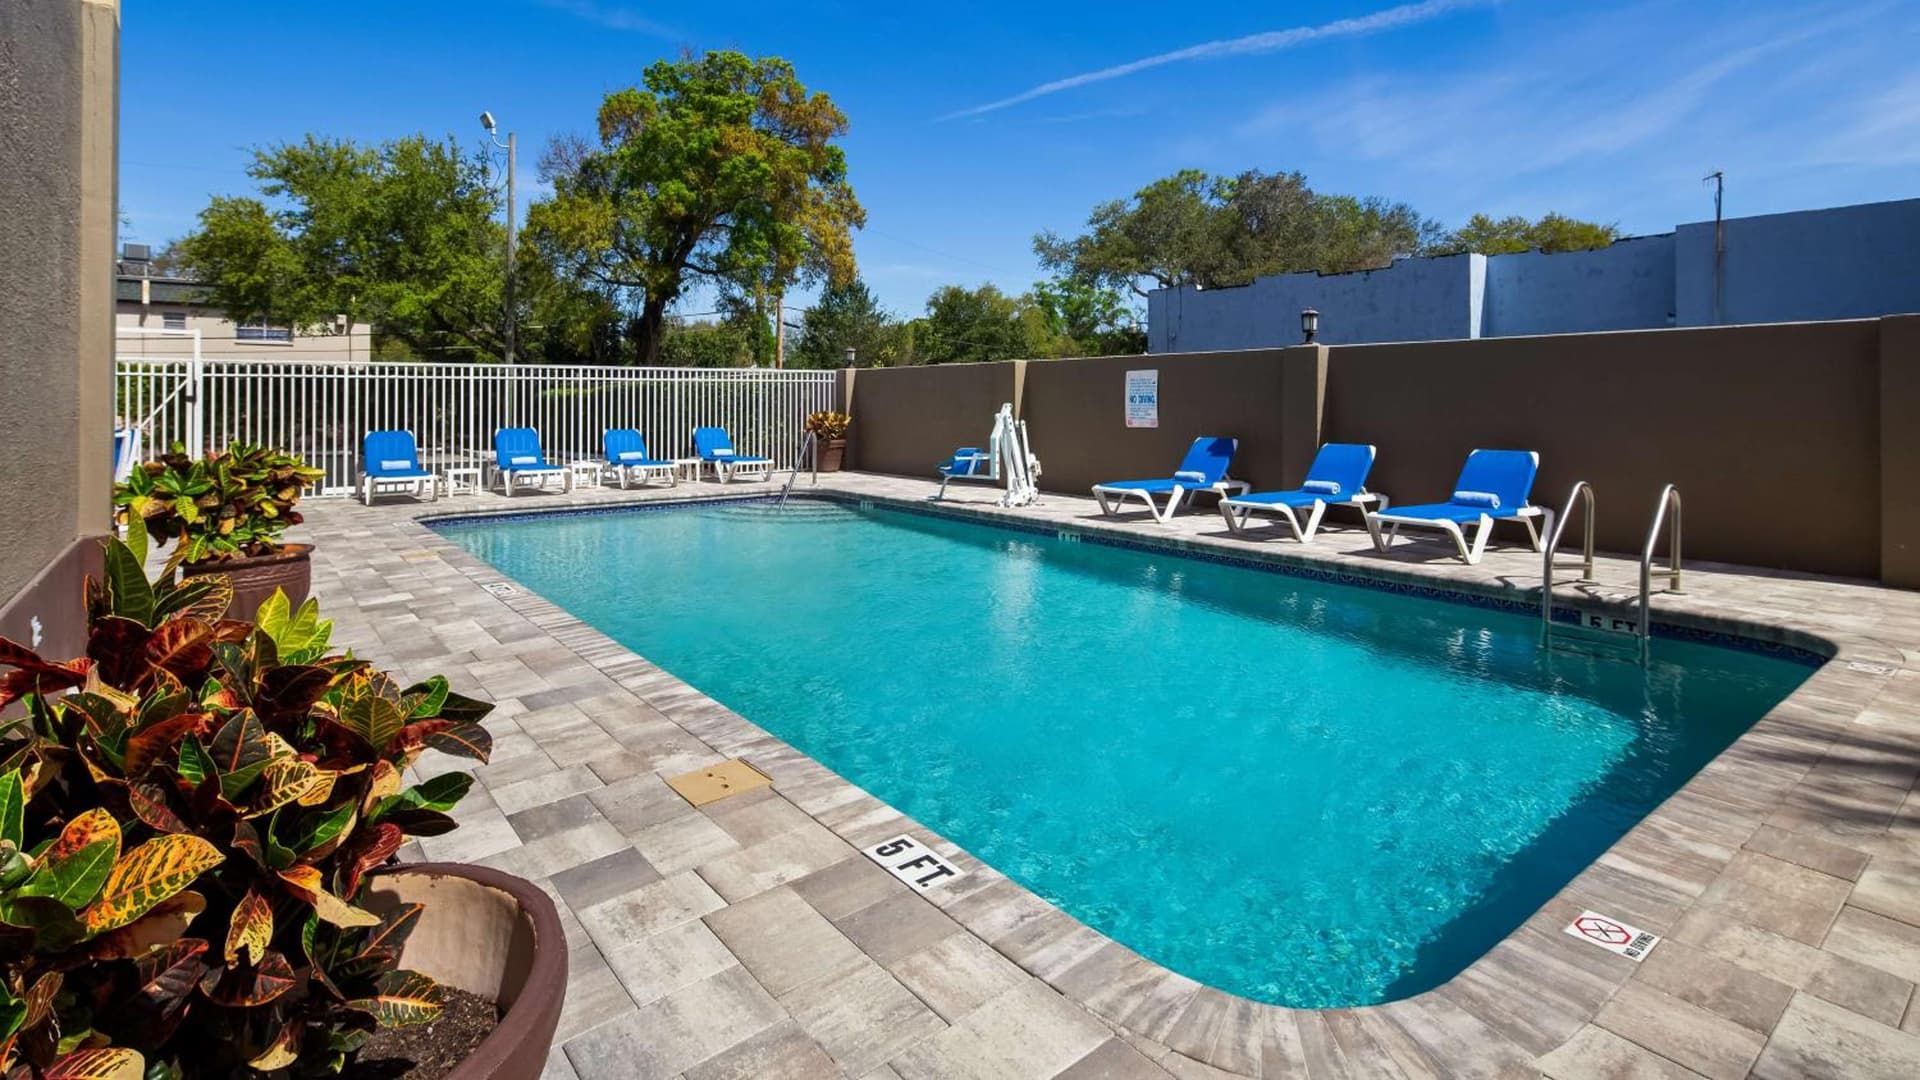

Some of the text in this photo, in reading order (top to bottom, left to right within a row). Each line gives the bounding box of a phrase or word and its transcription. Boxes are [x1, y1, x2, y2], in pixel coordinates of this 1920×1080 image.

[876, 839, 915, 857] 5
[1623, 932, 1655, 957] NO DIVING
